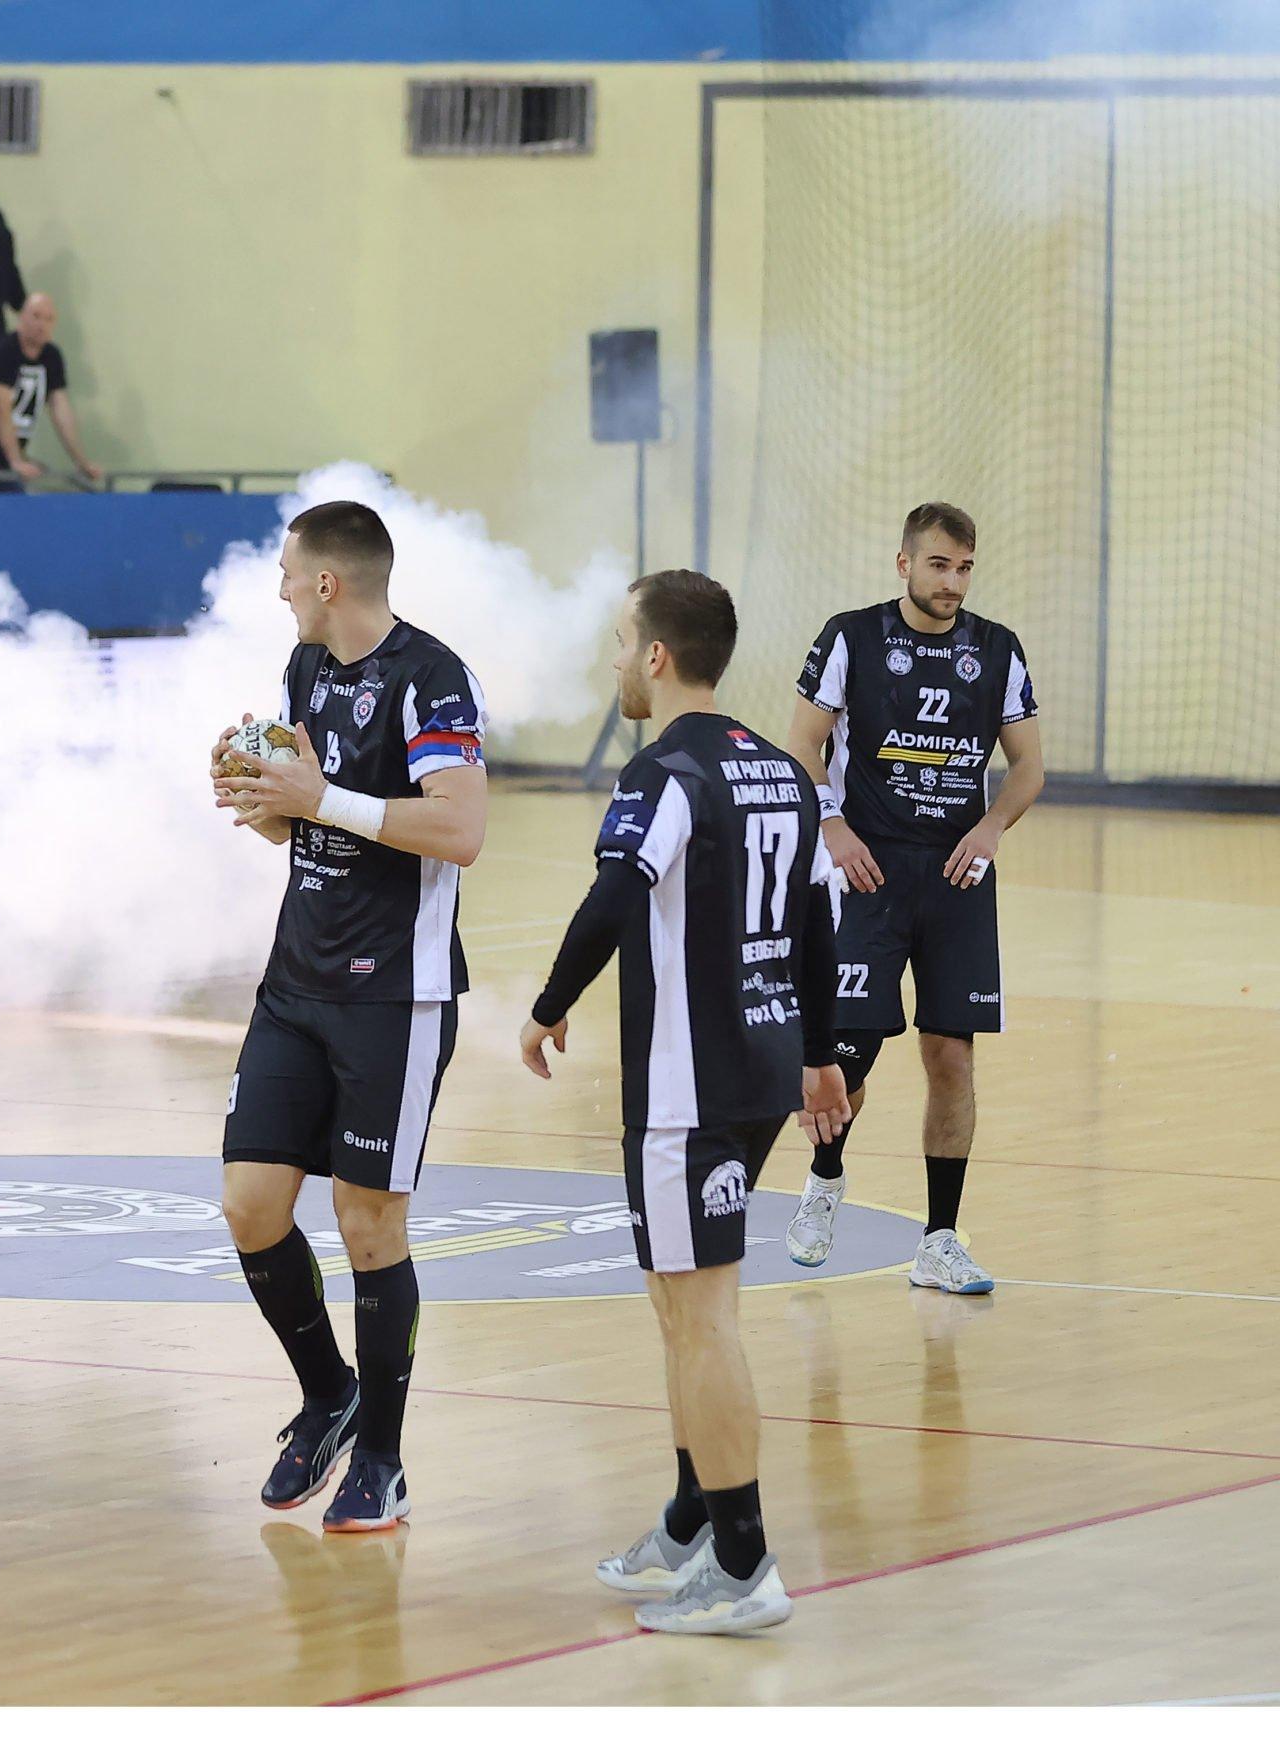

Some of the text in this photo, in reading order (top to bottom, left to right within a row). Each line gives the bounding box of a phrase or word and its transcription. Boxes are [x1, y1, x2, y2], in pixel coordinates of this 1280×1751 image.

[927, 647, 952, 660] unit
[439, 693, 462, 706] unit
[916, 686, 951, 724] 22
[882, 729, 985, 755] ADMIRAL
[946, 753, 985, 767] BET
[914, 803, 946, 818] jazak
[744, 811, 800, 935] 17
[836, 963, 869, 998] 22
[980, 991, 999, 1003] unit
[354, 1136, 389, 1153] unit
